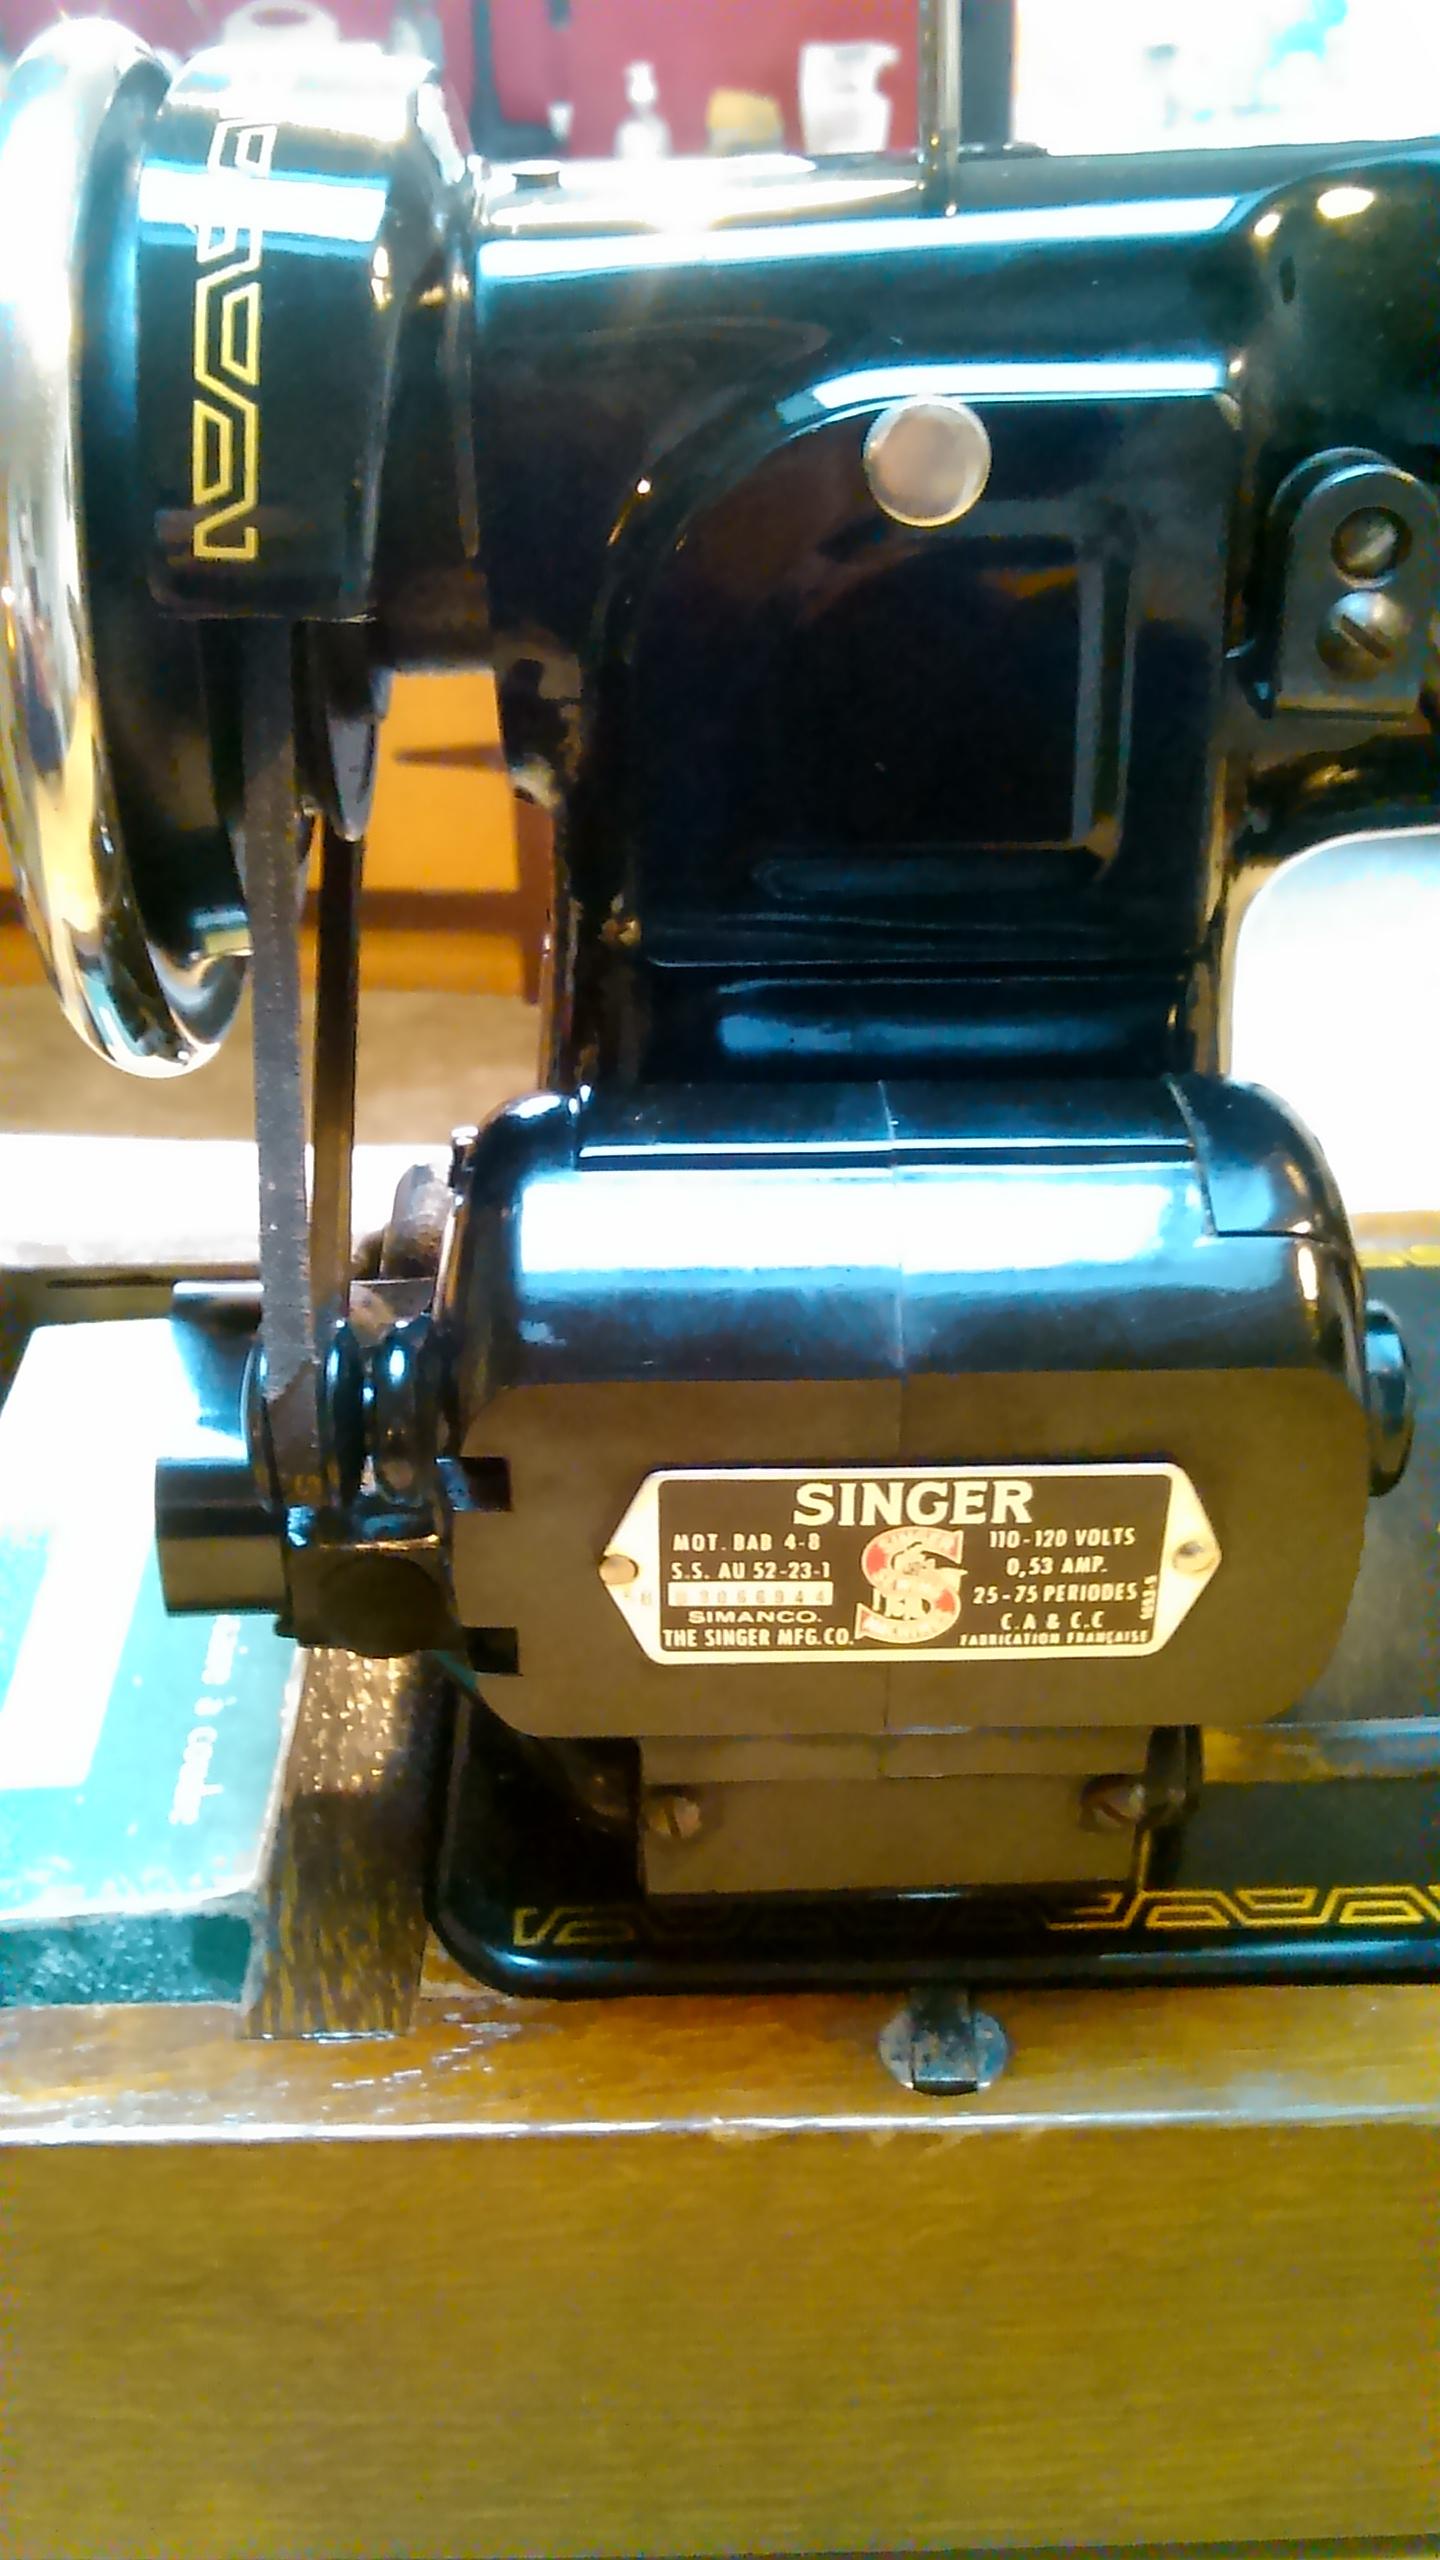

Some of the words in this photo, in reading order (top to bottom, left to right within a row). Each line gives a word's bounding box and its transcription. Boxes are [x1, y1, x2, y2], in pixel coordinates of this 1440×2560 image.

[794, 1481, 1033, 1526] SINGER
[673, 1534, 726, 1551] MOT.
[734, 1534, 772, 1551] BAB
[1075, 1528, 1135, 1546] VOLTS
[672, 1562, 709, 1579] S.S.
[718, 1562, 745, 1579] AU
[753, 1562, 829, 1579] 52-23-1
[1007, 1557, 1053, 1578] 0,53
[1061, 1556, 1107, 1573] AMP.
[1043, 1583, 1137, 1602] PERIODES
[688, 1611, 822, 1623] SIMANCO.
[1046, 1613, 1060, 1629] &
[663, 1629, 697, 1646] THE
[705, 1628, 770, 1646] SINGER
[960, 1633, 1060, 1646] FABRICATION
